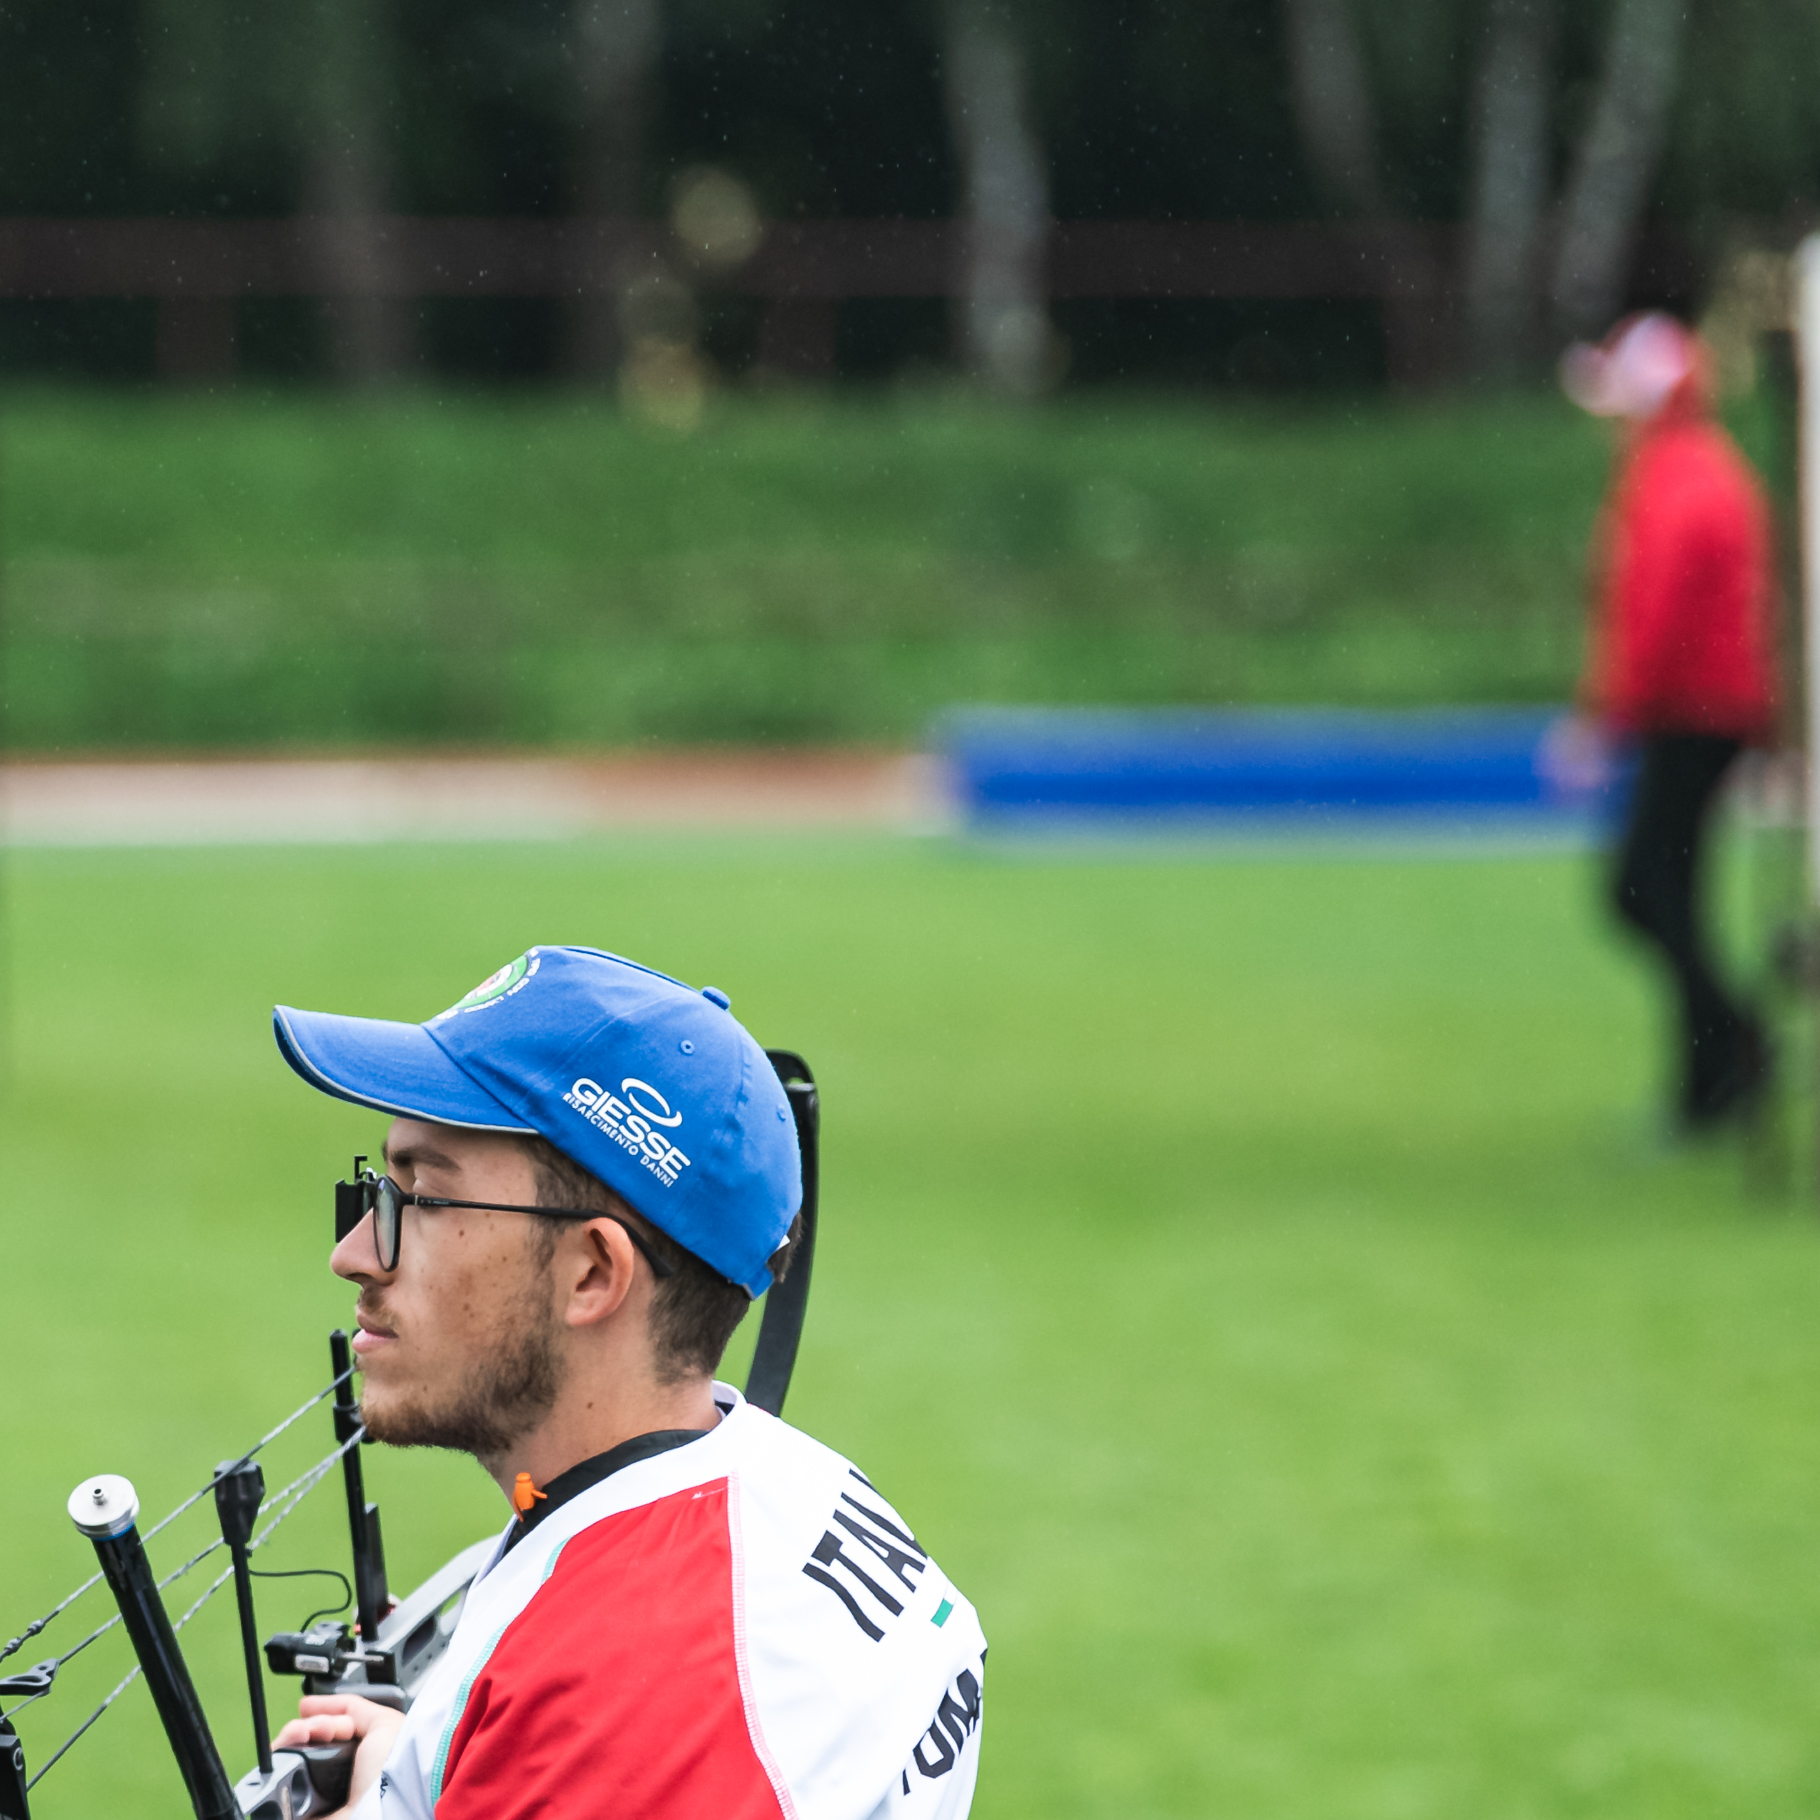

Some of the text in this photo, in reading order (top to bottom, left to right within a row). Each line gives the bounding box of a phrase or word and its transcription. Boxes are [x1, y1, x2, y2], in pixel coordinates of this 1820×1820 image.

[562, 1092, 674, 1188] RISARCIMENTO DANNI
[572, 1078, 691, 1179] GIESSE
